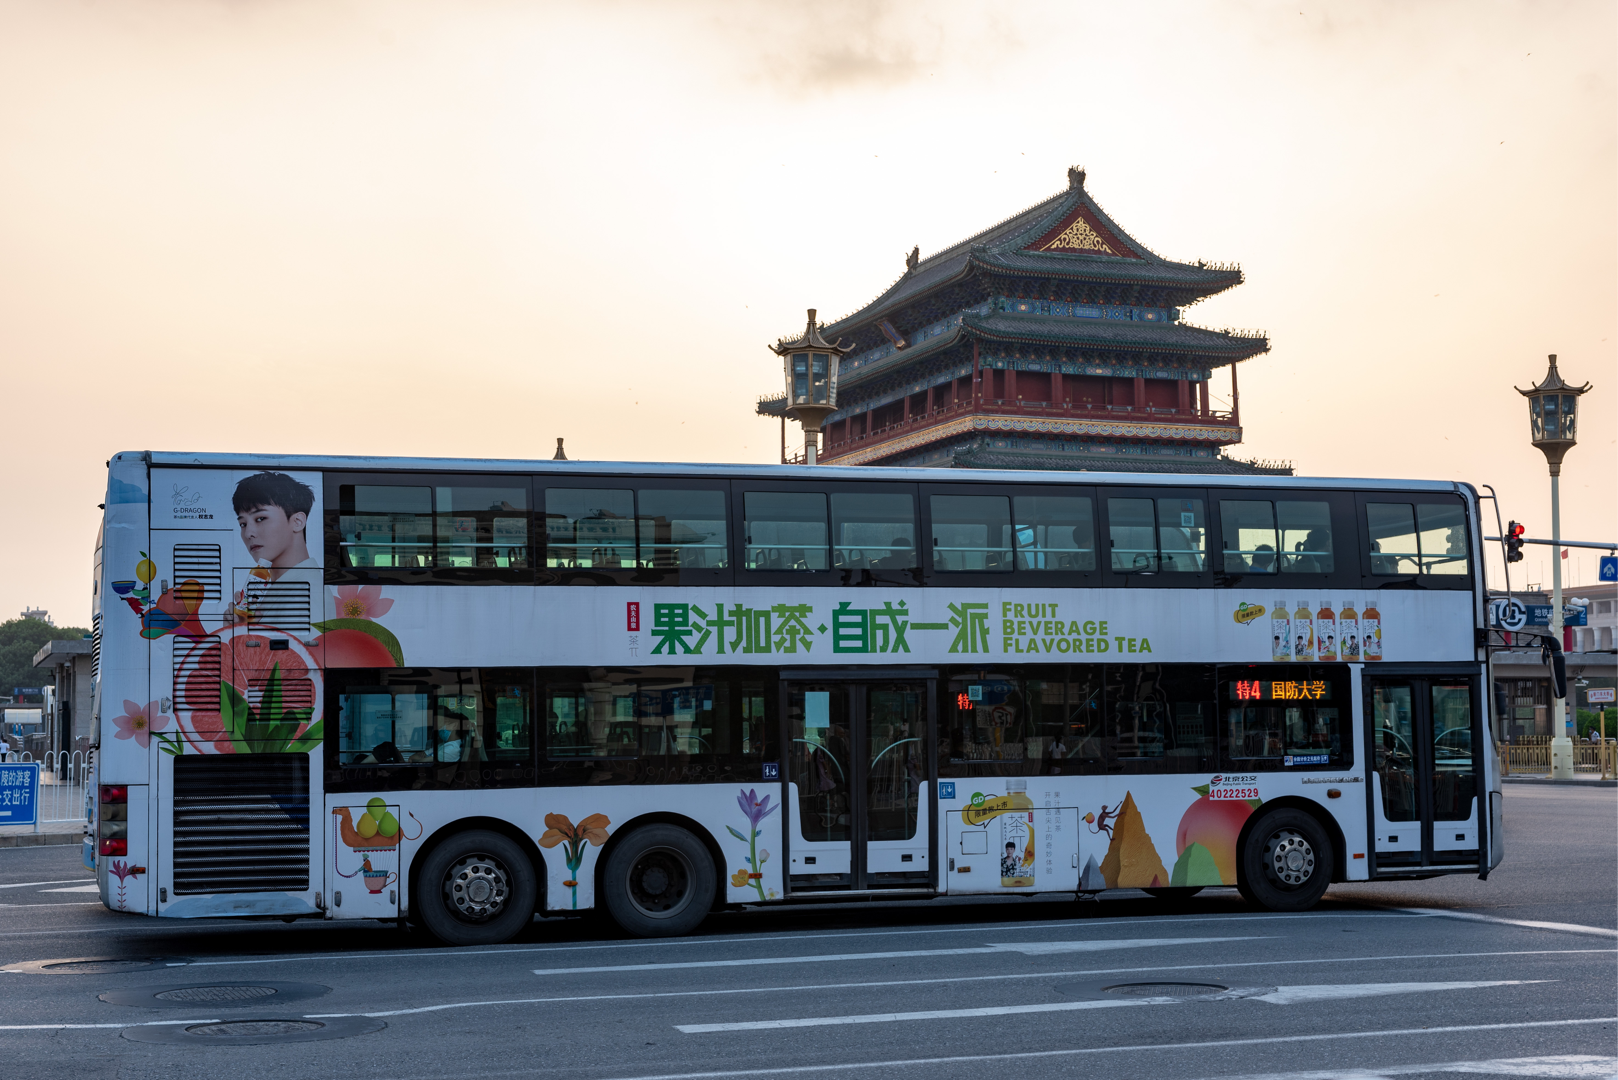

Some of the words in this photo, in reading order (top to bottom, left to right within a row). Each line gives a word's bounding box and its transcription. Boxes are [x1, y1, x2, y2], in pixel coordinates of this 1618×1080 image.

[1002, 602, 1058, 619] FRUIT
[1002, 619, 1109, 637] BEVERAGE
[1002, 637, 1110, 654] FLAVORED
[1114, 637, 1153, 654] TEA
[1236, 680, 1261, 700] 特4
[1272, 680, 1326, 700] 国防大学
[0, 770, 31, 786] 陵的游客
[0, 788, 30, 806] 交出行
[972, 795, 985, 805] GD
[1209, 787, 1259, 799] 40222529
